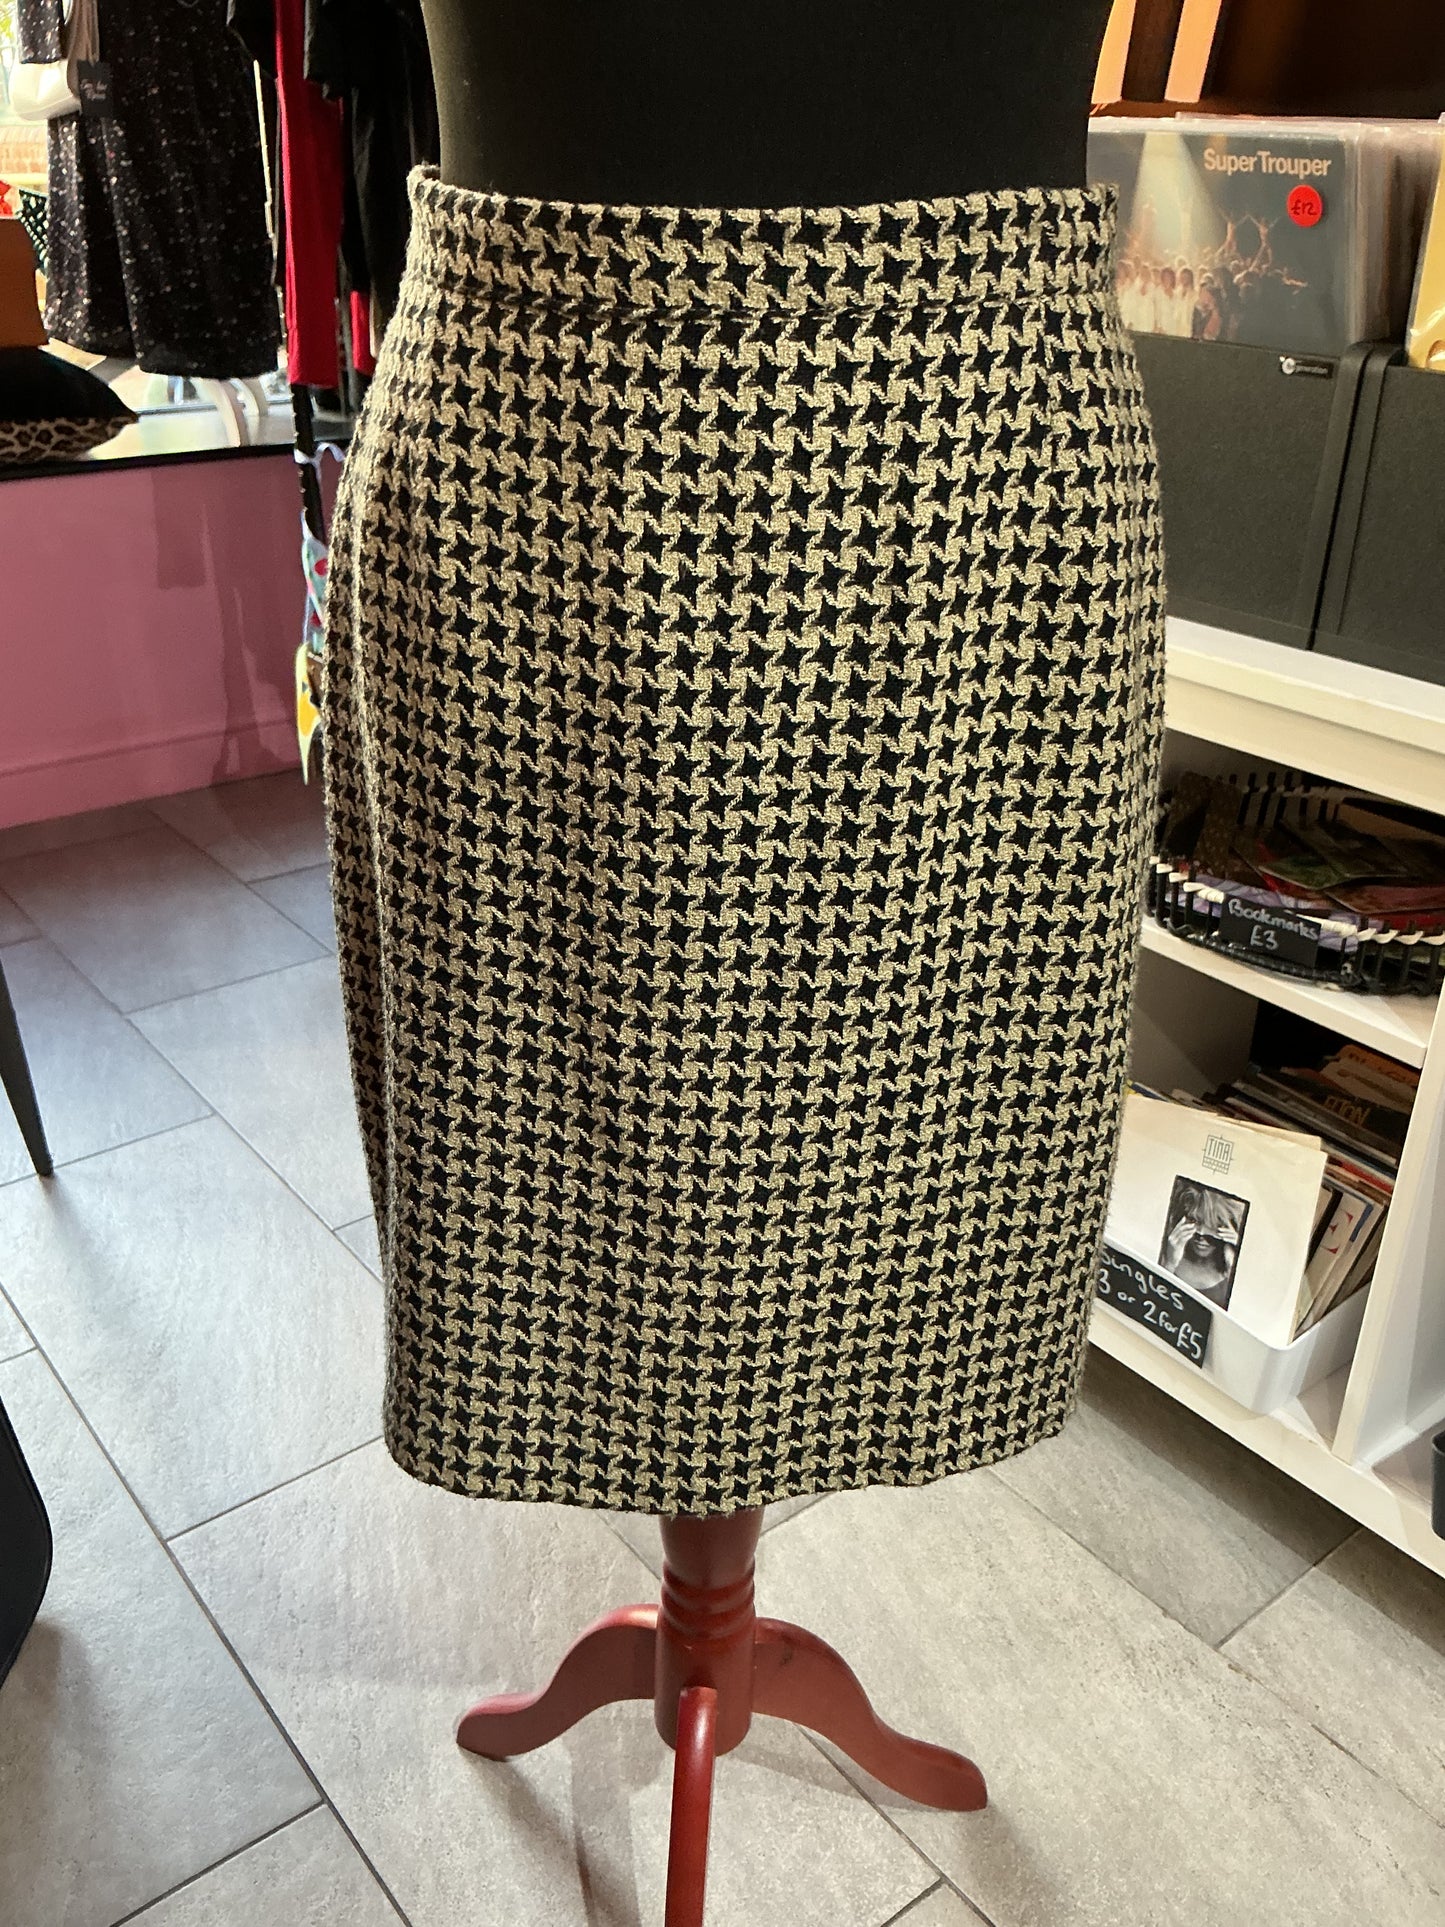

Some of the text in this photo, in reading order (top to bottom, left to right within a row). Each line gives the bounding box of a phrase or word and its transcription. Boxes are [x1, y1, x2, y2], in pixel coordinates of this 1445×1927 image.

[1203, 148, 1332, 180] Super Trouper
[1291, 199, 1318, 216] £12
[1228, 898, 1319, 940] Bookmarks
[1250, 924, 1278, 950] £3
[1117, 1291, 1136, 1303] or
[1176, 1322, 1203, 1360] £5
